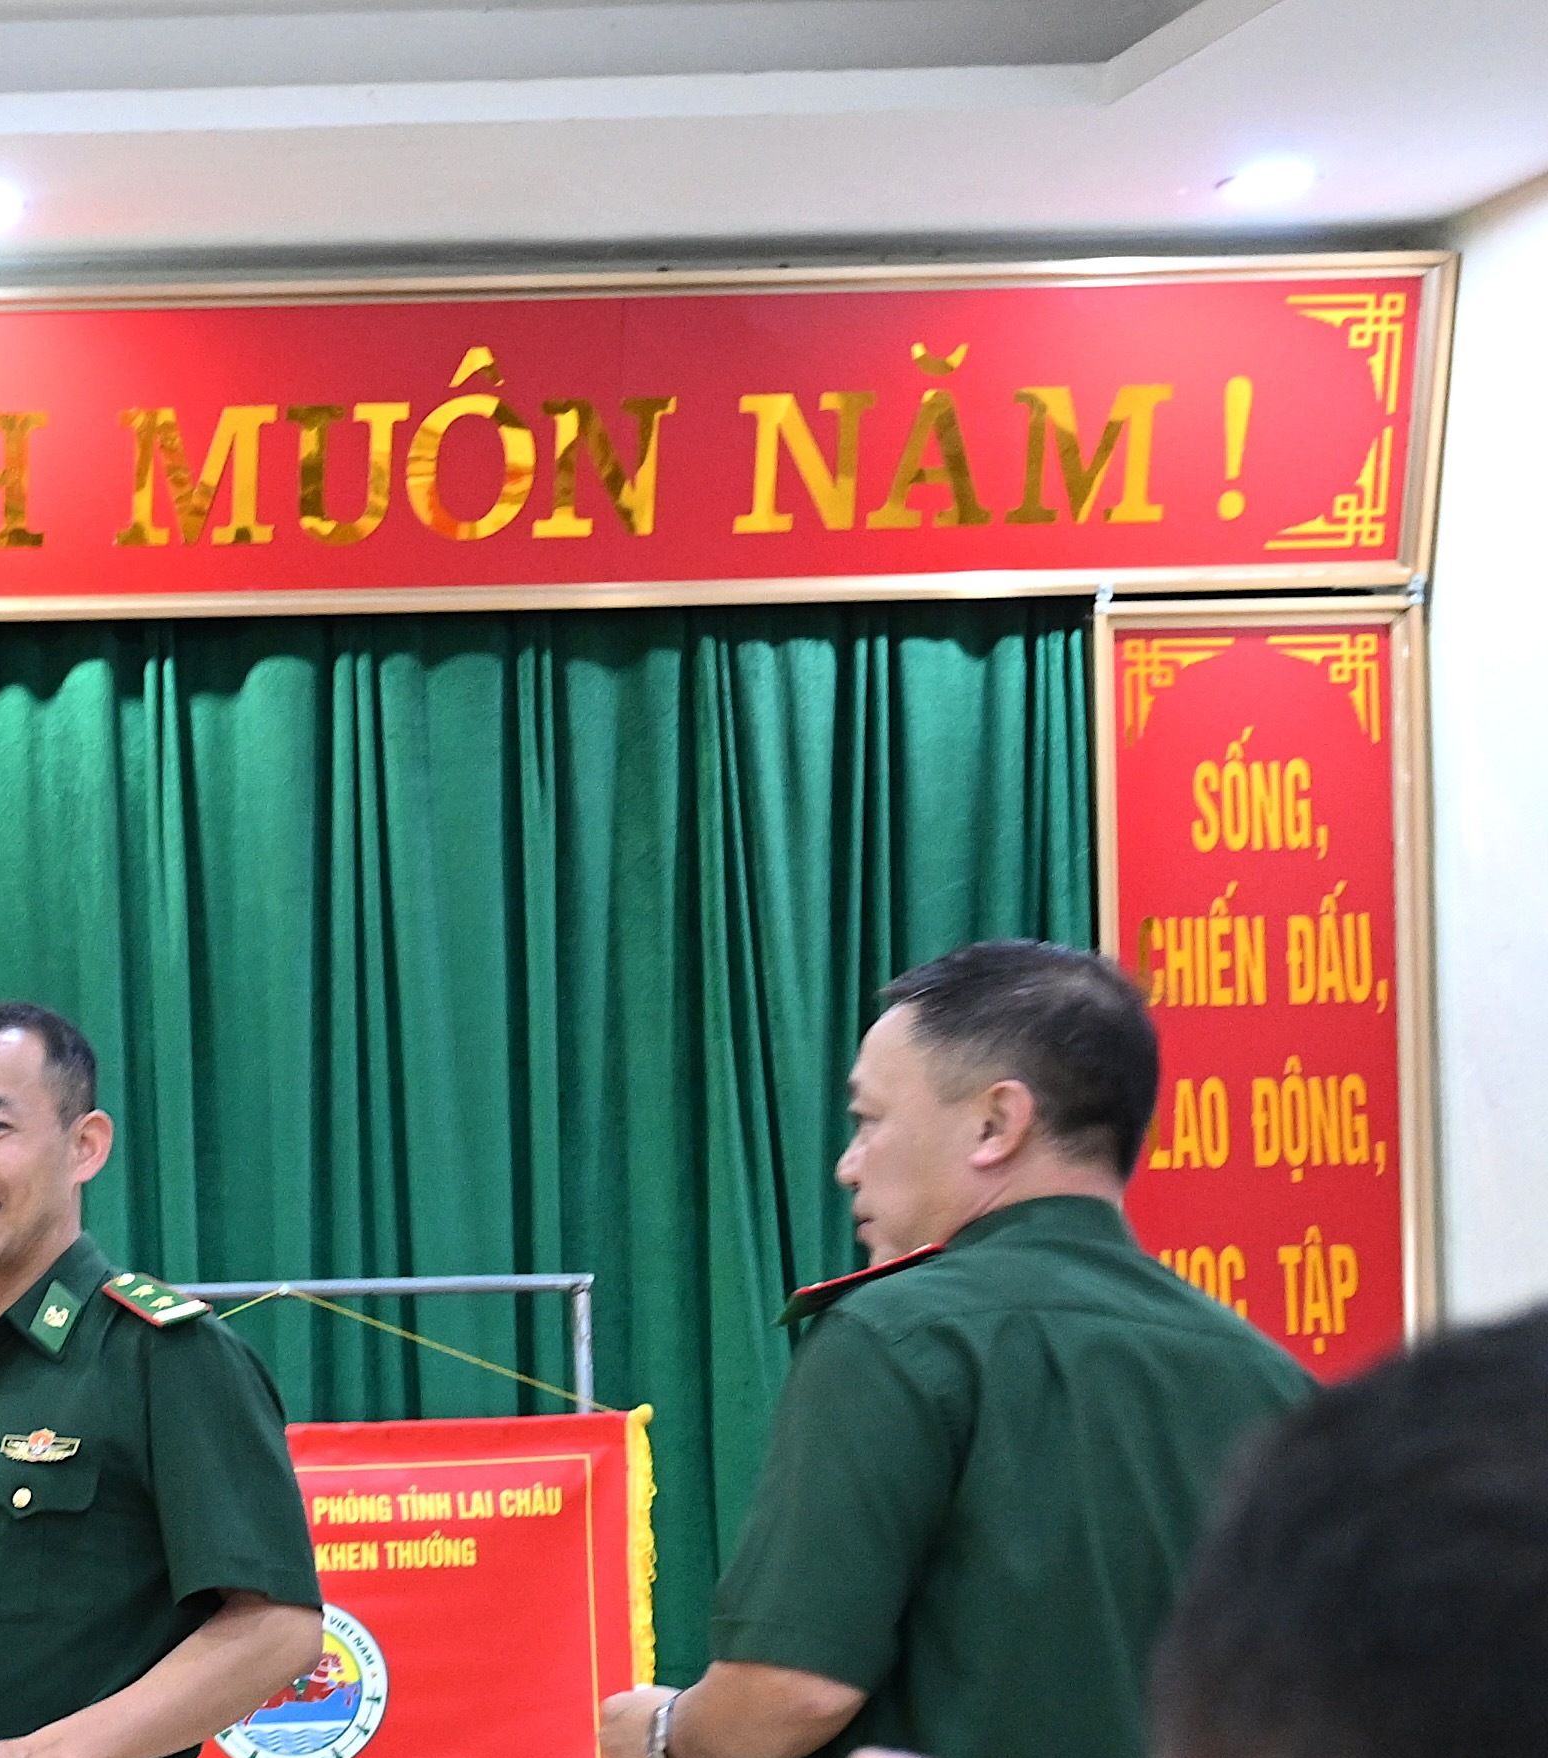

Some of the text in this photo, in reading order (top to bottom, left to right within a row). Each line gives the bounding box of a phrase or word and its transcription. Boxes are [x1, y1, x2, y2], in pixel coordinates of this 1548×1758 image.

[112, 346, 676, 546] MUÔN
[732, 342, 1174, 534] NĂM
[1190, 726, 1328, 859] SỐNG,
[1286, 880, 1388, 1014] ĐẤU,
[1251, 1055, 1386, 1183] ĐỘNG,
[1278, 1225, 1359, 1355] TẬP
[315, 1530, 477, 1572] KHEN THƯỞNG
[396, 1485, 452, 1521] TỈNH
[457, 1491, 494, 1520] LAI
[499, 1482, 562, 1517] CHÂU
